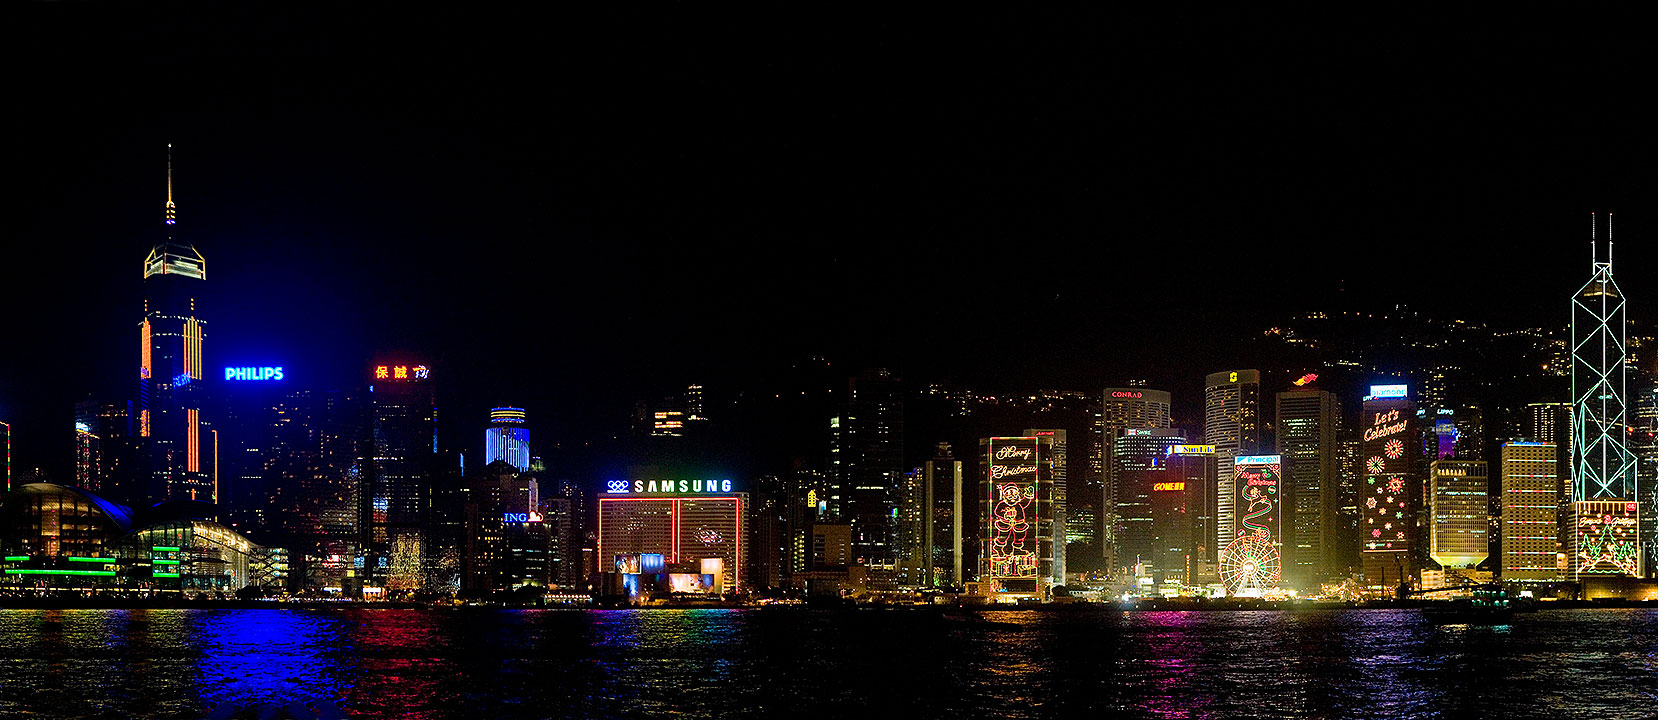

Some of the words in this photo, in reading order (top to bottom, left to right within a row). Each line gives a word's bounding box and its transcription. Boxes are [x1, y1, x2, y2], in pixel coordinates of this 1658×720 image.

[225, 366, 283, 380] PHILIPS
[376, 365, 407, 379] 保誠
[1374, 409, 1399, 426] Let's
[1364, 420, 1407, 442] Celebrate!
[995, 445, 1031, 460] Merry
[991, 465, 1037, 479] Christmas
[634, 479, 732, 493] SAMSUNG
[504, 512, 527, 522] ING
